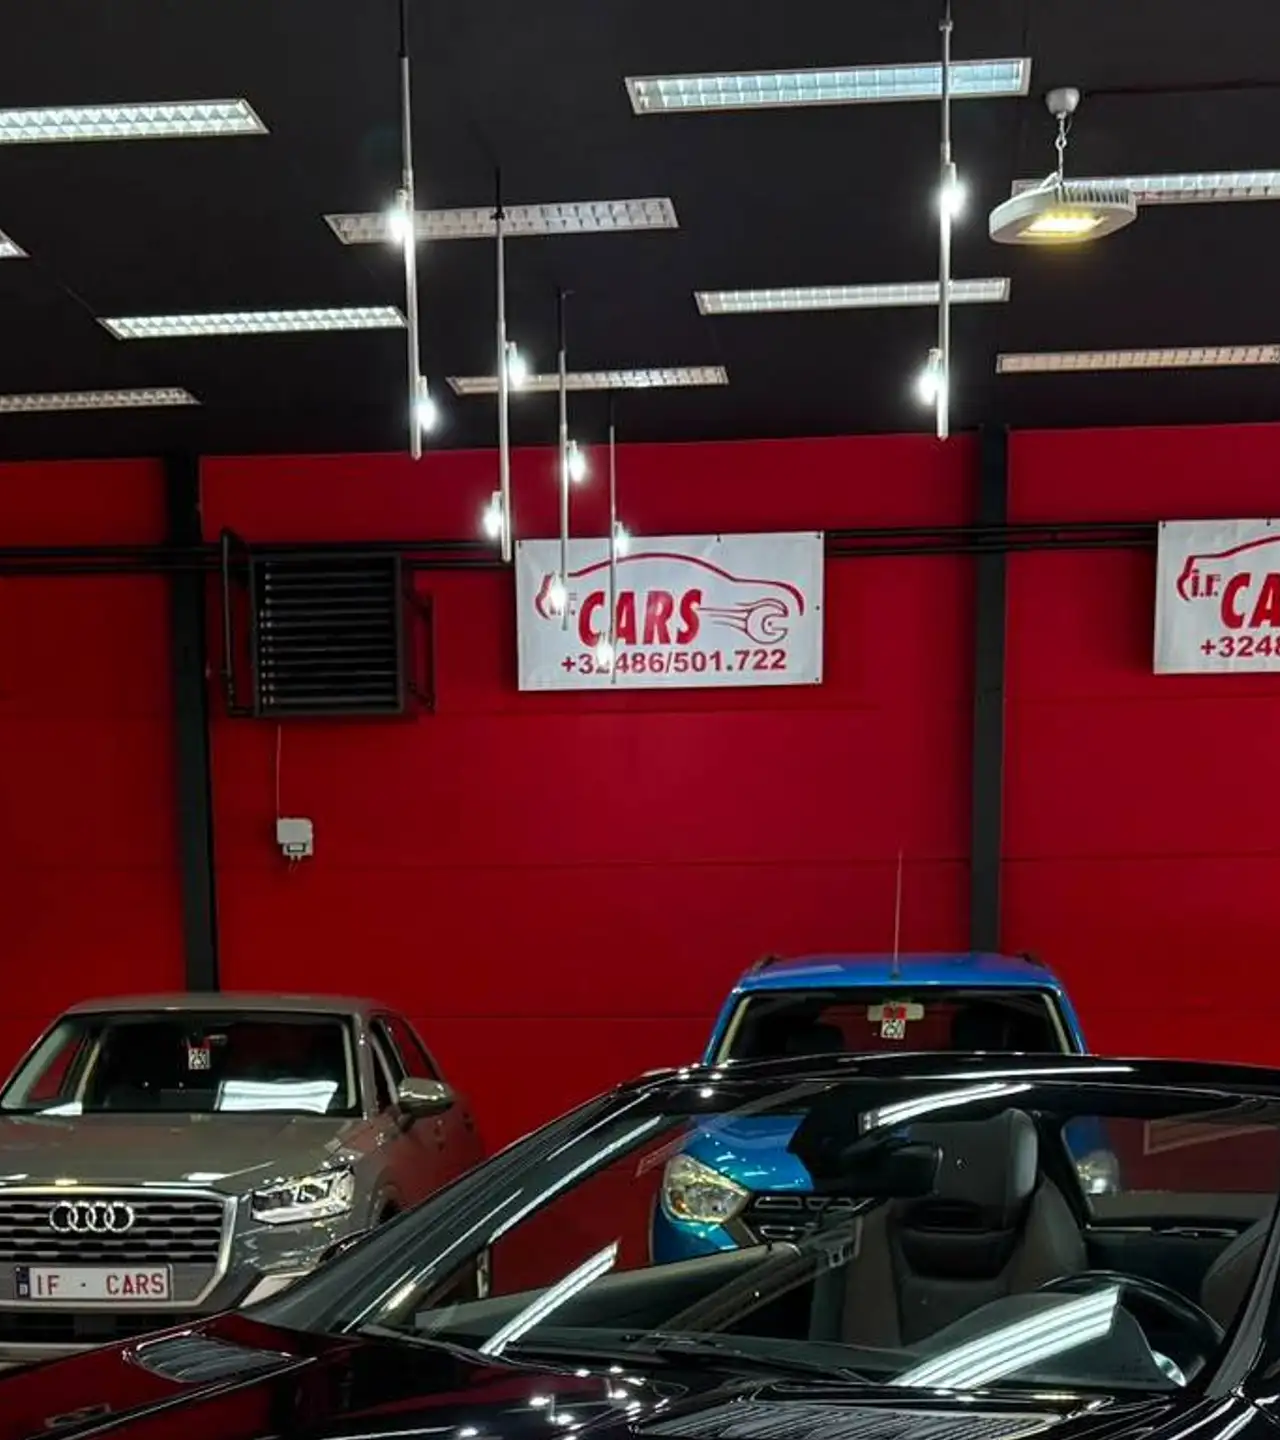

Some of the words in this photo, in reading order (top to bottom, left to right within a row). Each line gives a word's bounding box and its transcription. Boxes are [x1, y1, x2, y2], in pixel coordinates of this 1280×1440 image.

[578, 589, 702, 647] CARS
[37, 1275, 60, 1296] IF
[106, 1273, 165, 1295] CARS
